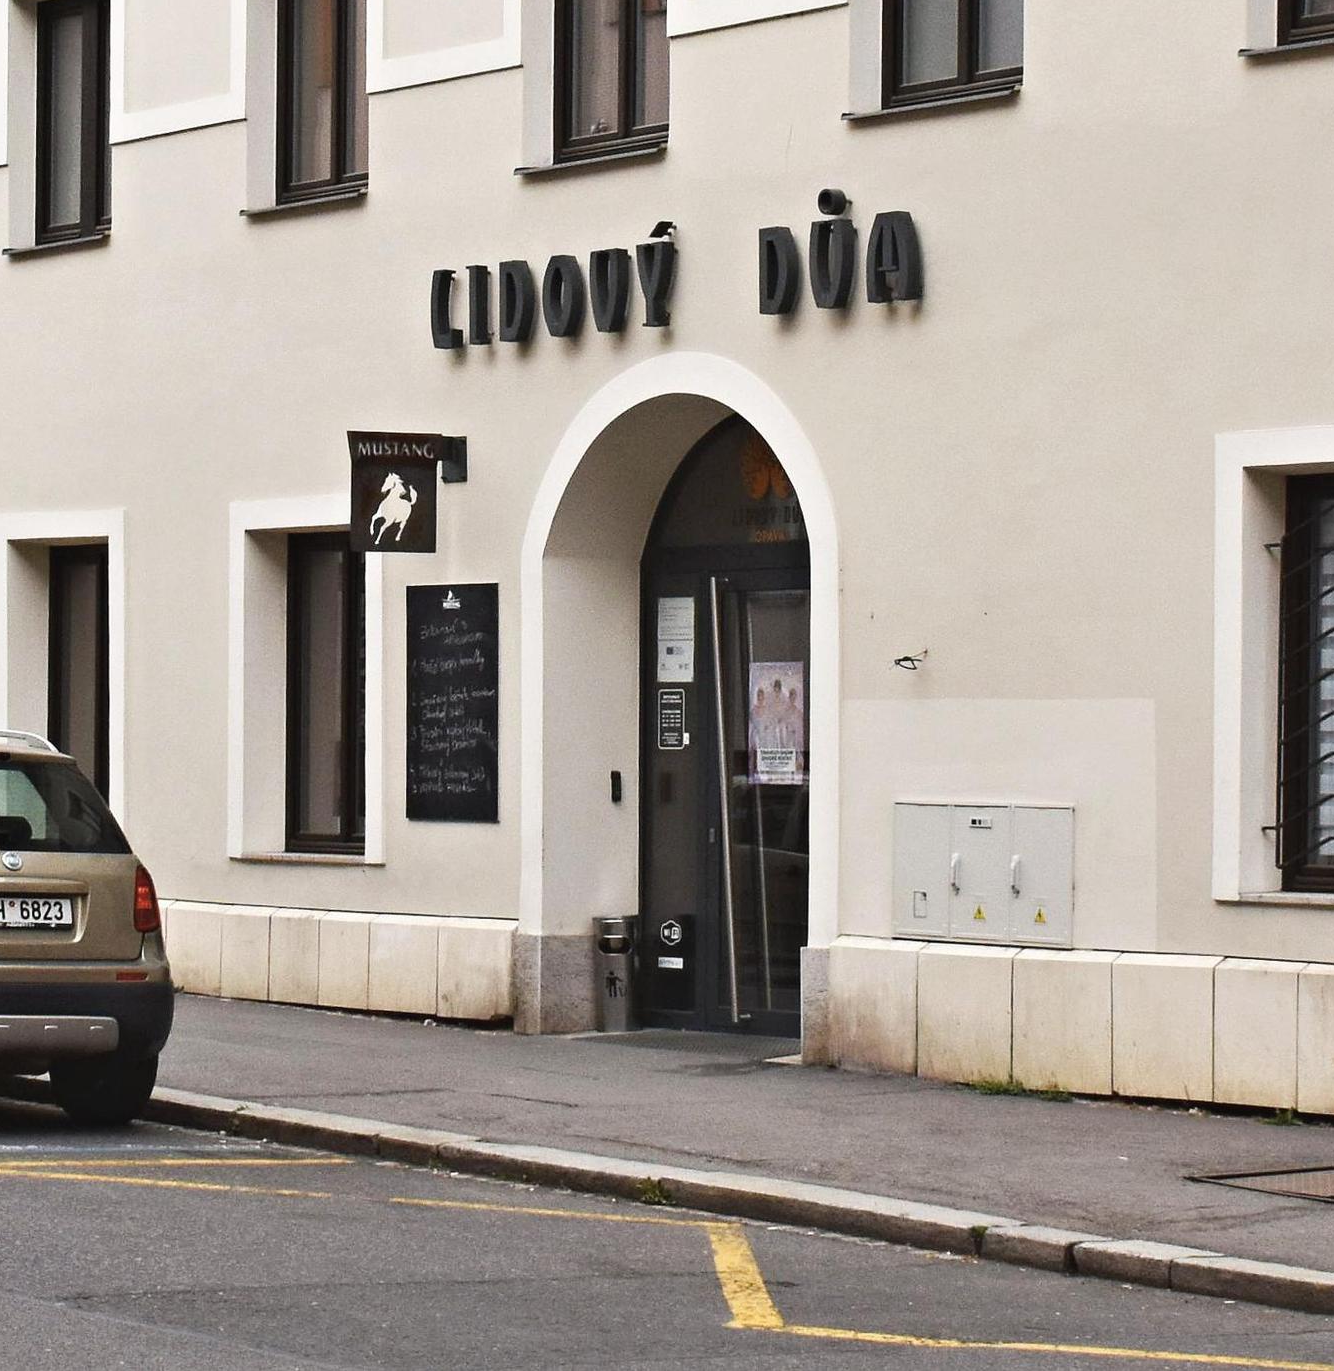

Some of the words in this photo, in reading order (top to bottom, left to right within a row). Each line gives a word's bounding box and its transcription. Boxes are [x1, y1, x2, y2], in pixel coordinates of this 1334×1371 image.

[430, 221, 677, 349] LIDOVÝ
[357, 441, 435, 459] MUSTANG
[20, 900, 64, 921] 6823
